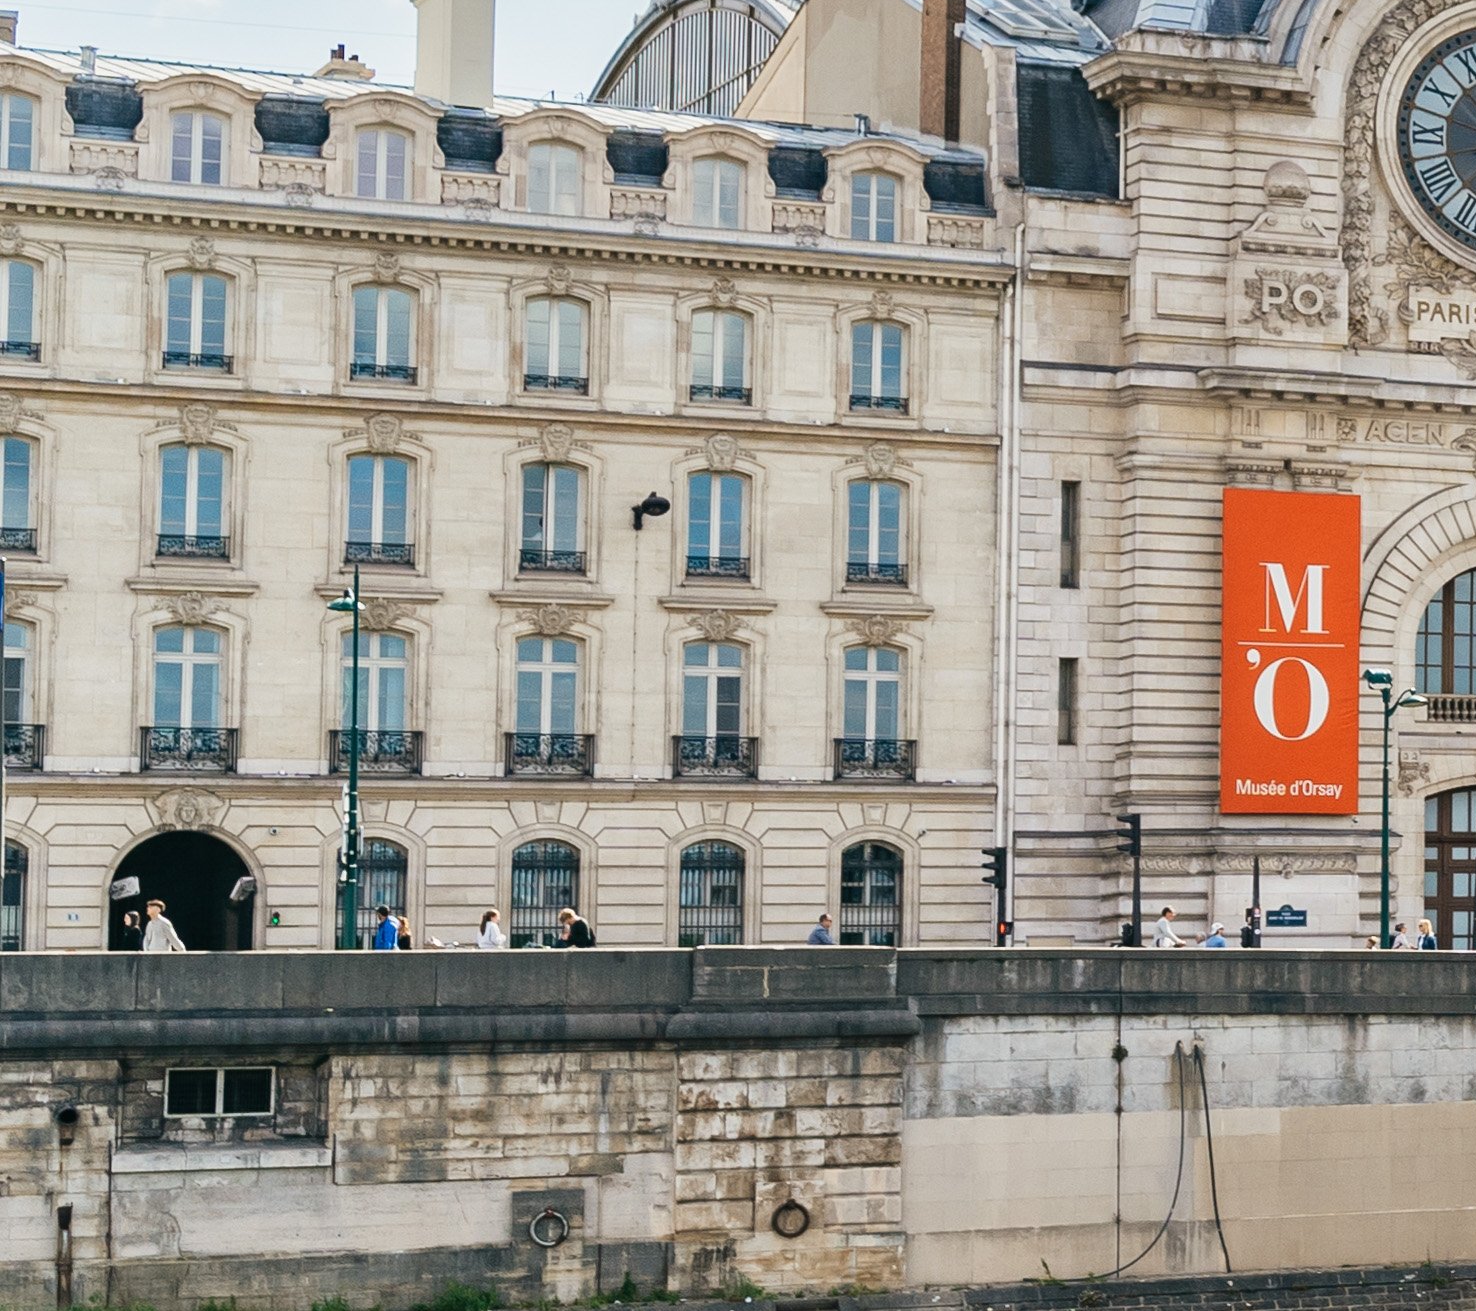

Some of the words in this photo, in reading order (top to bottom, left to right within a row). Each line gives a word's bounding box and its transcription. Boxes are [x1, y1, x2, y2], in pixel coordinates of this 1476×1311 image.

[1423, 77, 1457, 108] X
[1412, 121, 1444, 146] IX
[1420, 159, 1457, 203] VIII
[1261, 280, 1324, 315] PO
[1258, 561, 1331, 634] M
[1236, 778, 1286, 796] Musée
[1290, 779, 1343, 799] d'Orsay
